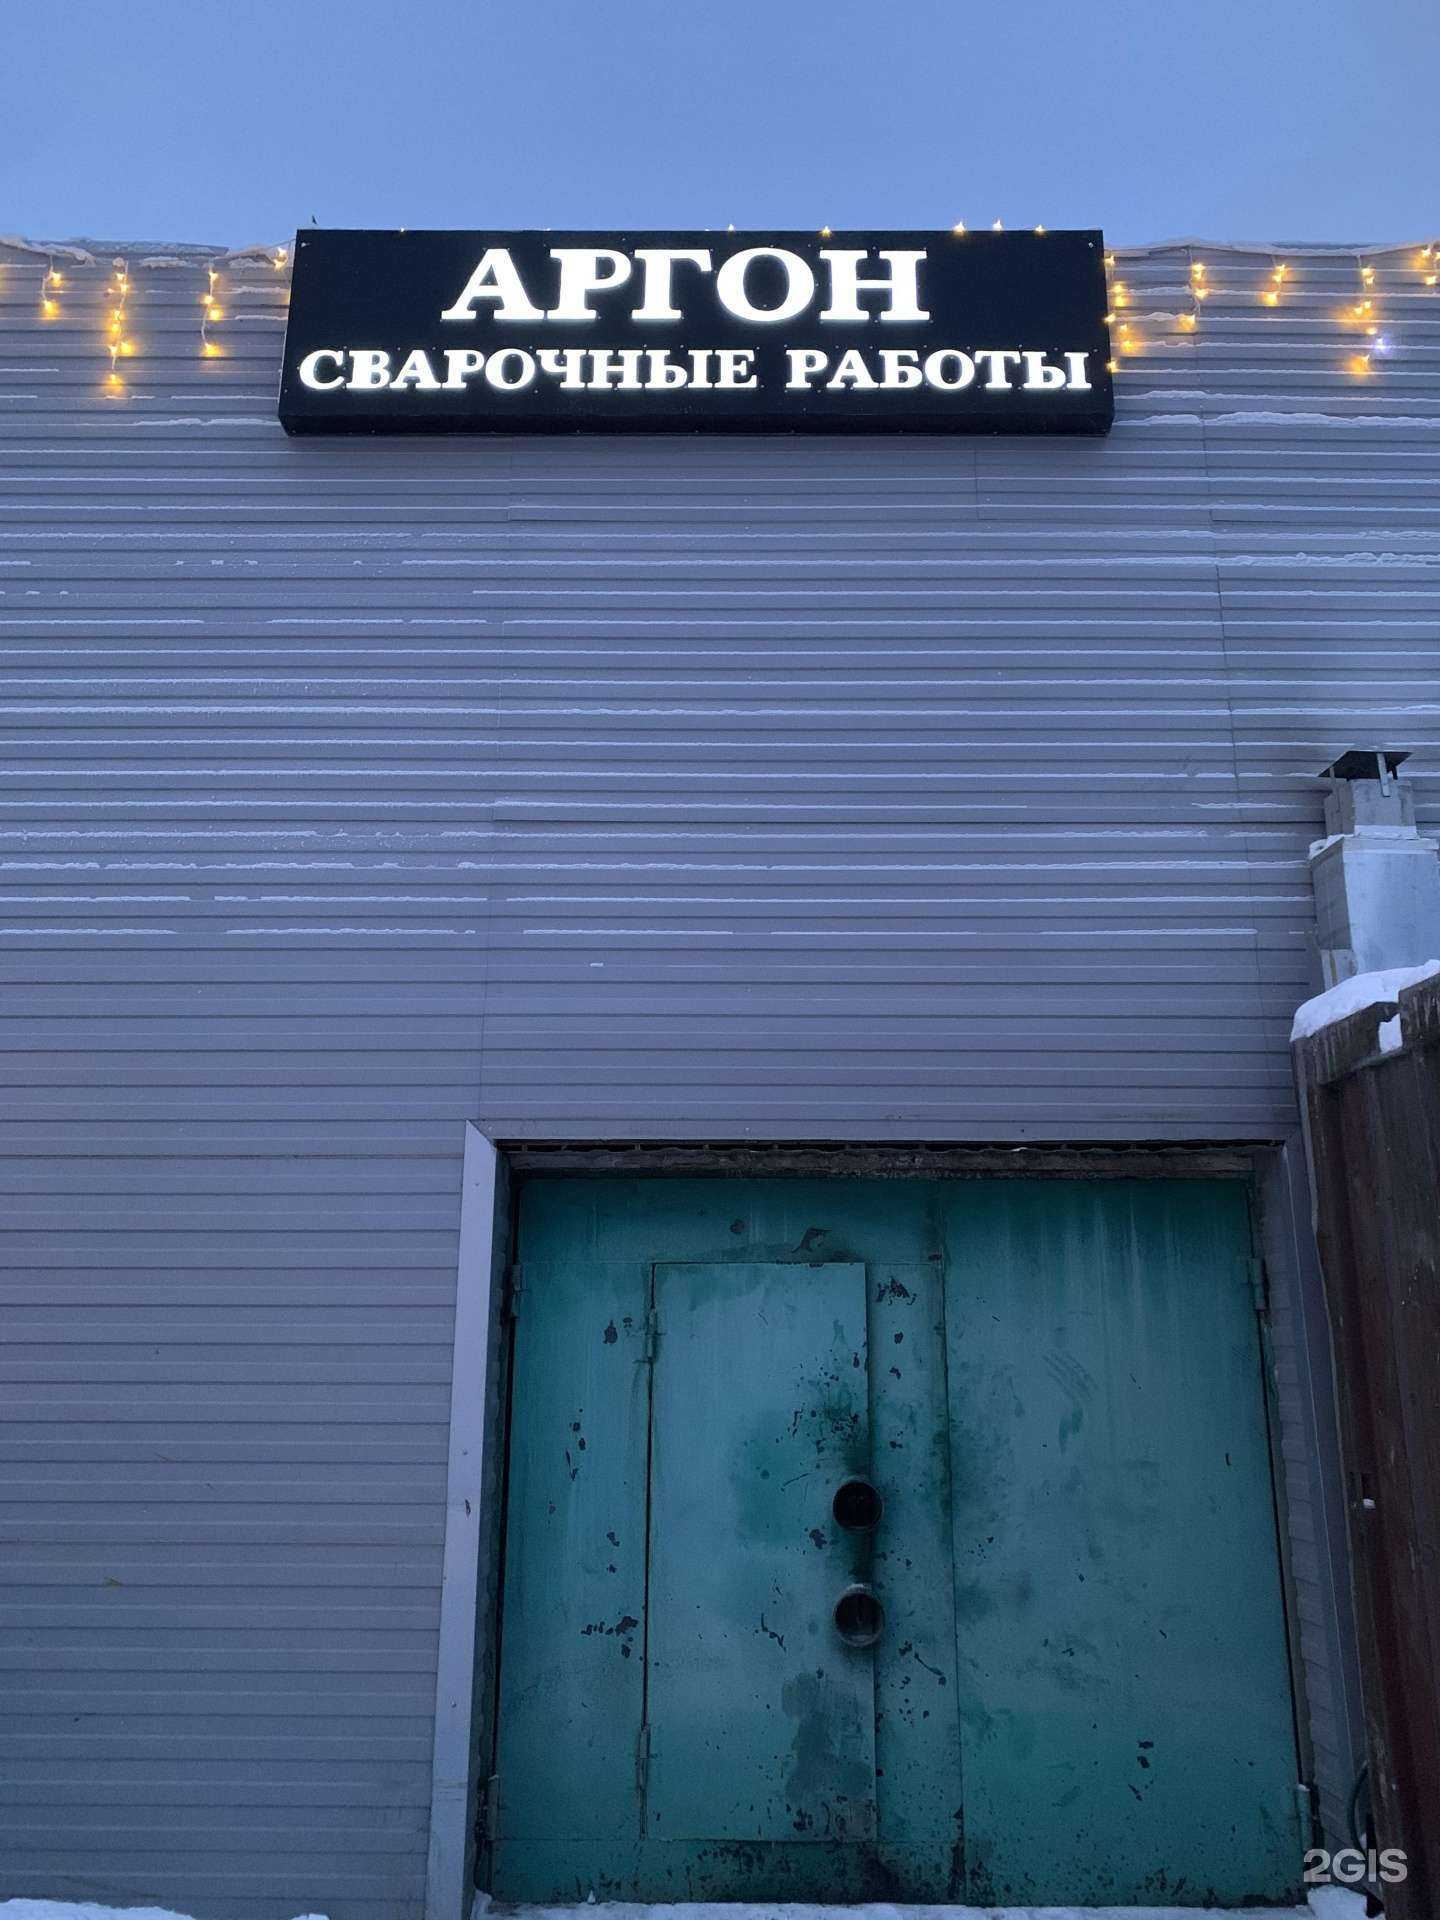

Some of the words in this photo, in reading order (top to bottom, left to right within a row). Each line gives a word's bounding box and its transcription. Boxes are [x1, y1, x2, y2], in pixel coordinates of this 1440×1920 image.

[441, 247, 931, 323] АРГОН
[298, 348, 760, 391] СВАРОЧНЫЕ
[785, 349, 1092, 391] РАБОТЫ
